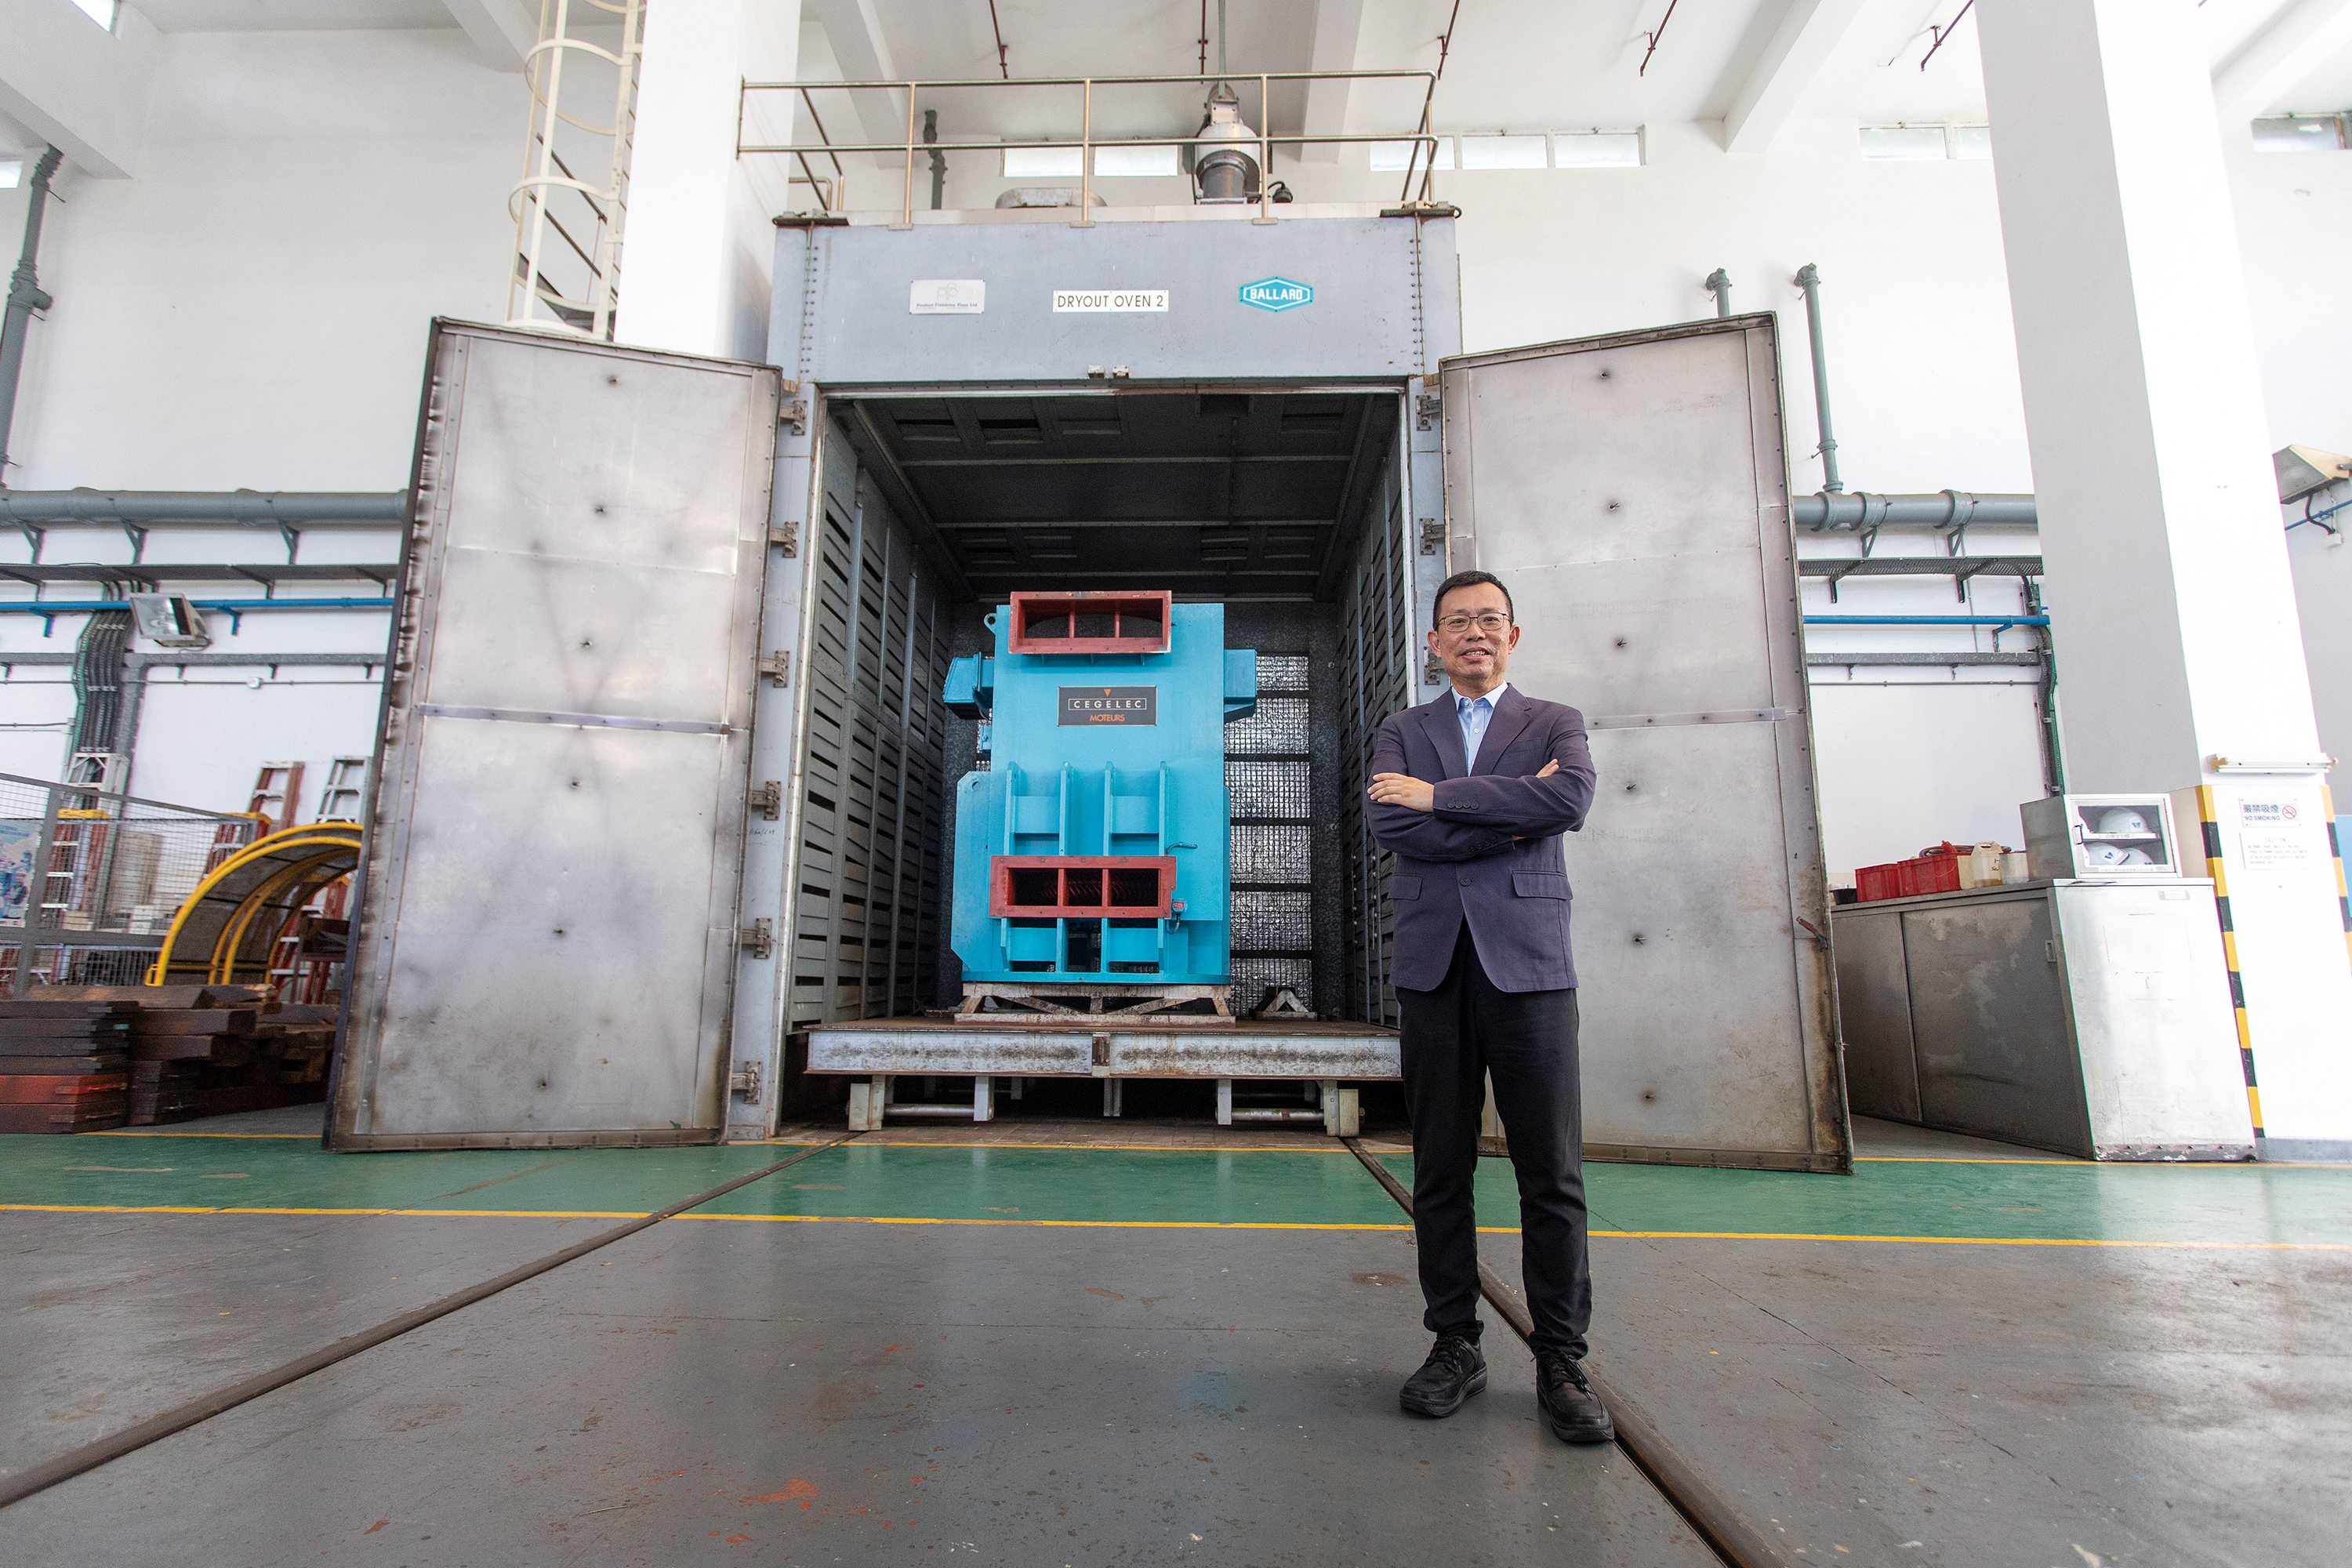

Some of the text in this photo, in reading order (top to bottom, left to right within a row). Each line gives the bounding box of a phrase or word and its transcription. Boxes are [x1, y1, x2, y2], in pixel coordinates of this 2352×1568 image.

[1250, 288, 1303, 300] BALLARD
[1058, 295, 1163, 307] DRYOUT OVEN 2
[1073, 700, 1142, 709] CEGELEC
[2243, 804, 2279, 813] 嚴禁吸煙
